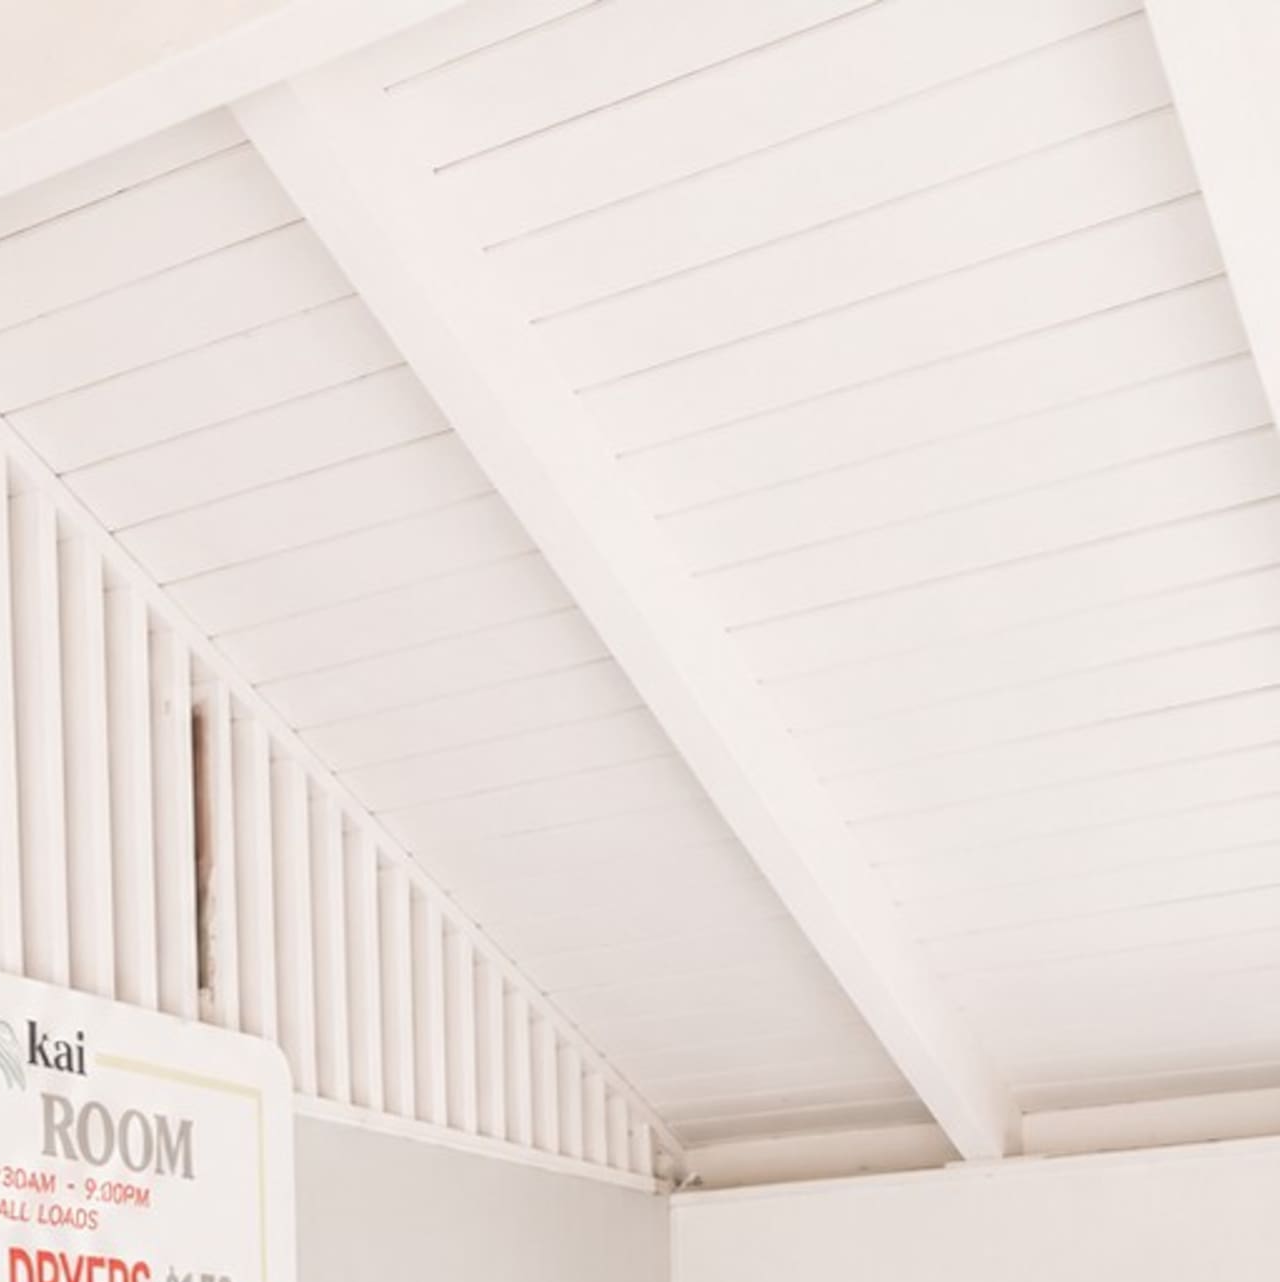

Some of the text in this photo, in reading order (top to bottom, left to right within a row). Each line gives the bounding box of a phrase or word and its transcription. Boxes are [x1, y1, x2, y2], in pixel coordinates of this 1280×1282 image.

[27, 1020, 87, 1077] kai
[40, 1092, 195, 1180] ROOM
[37, 1203, 99, 1230] LOADS
